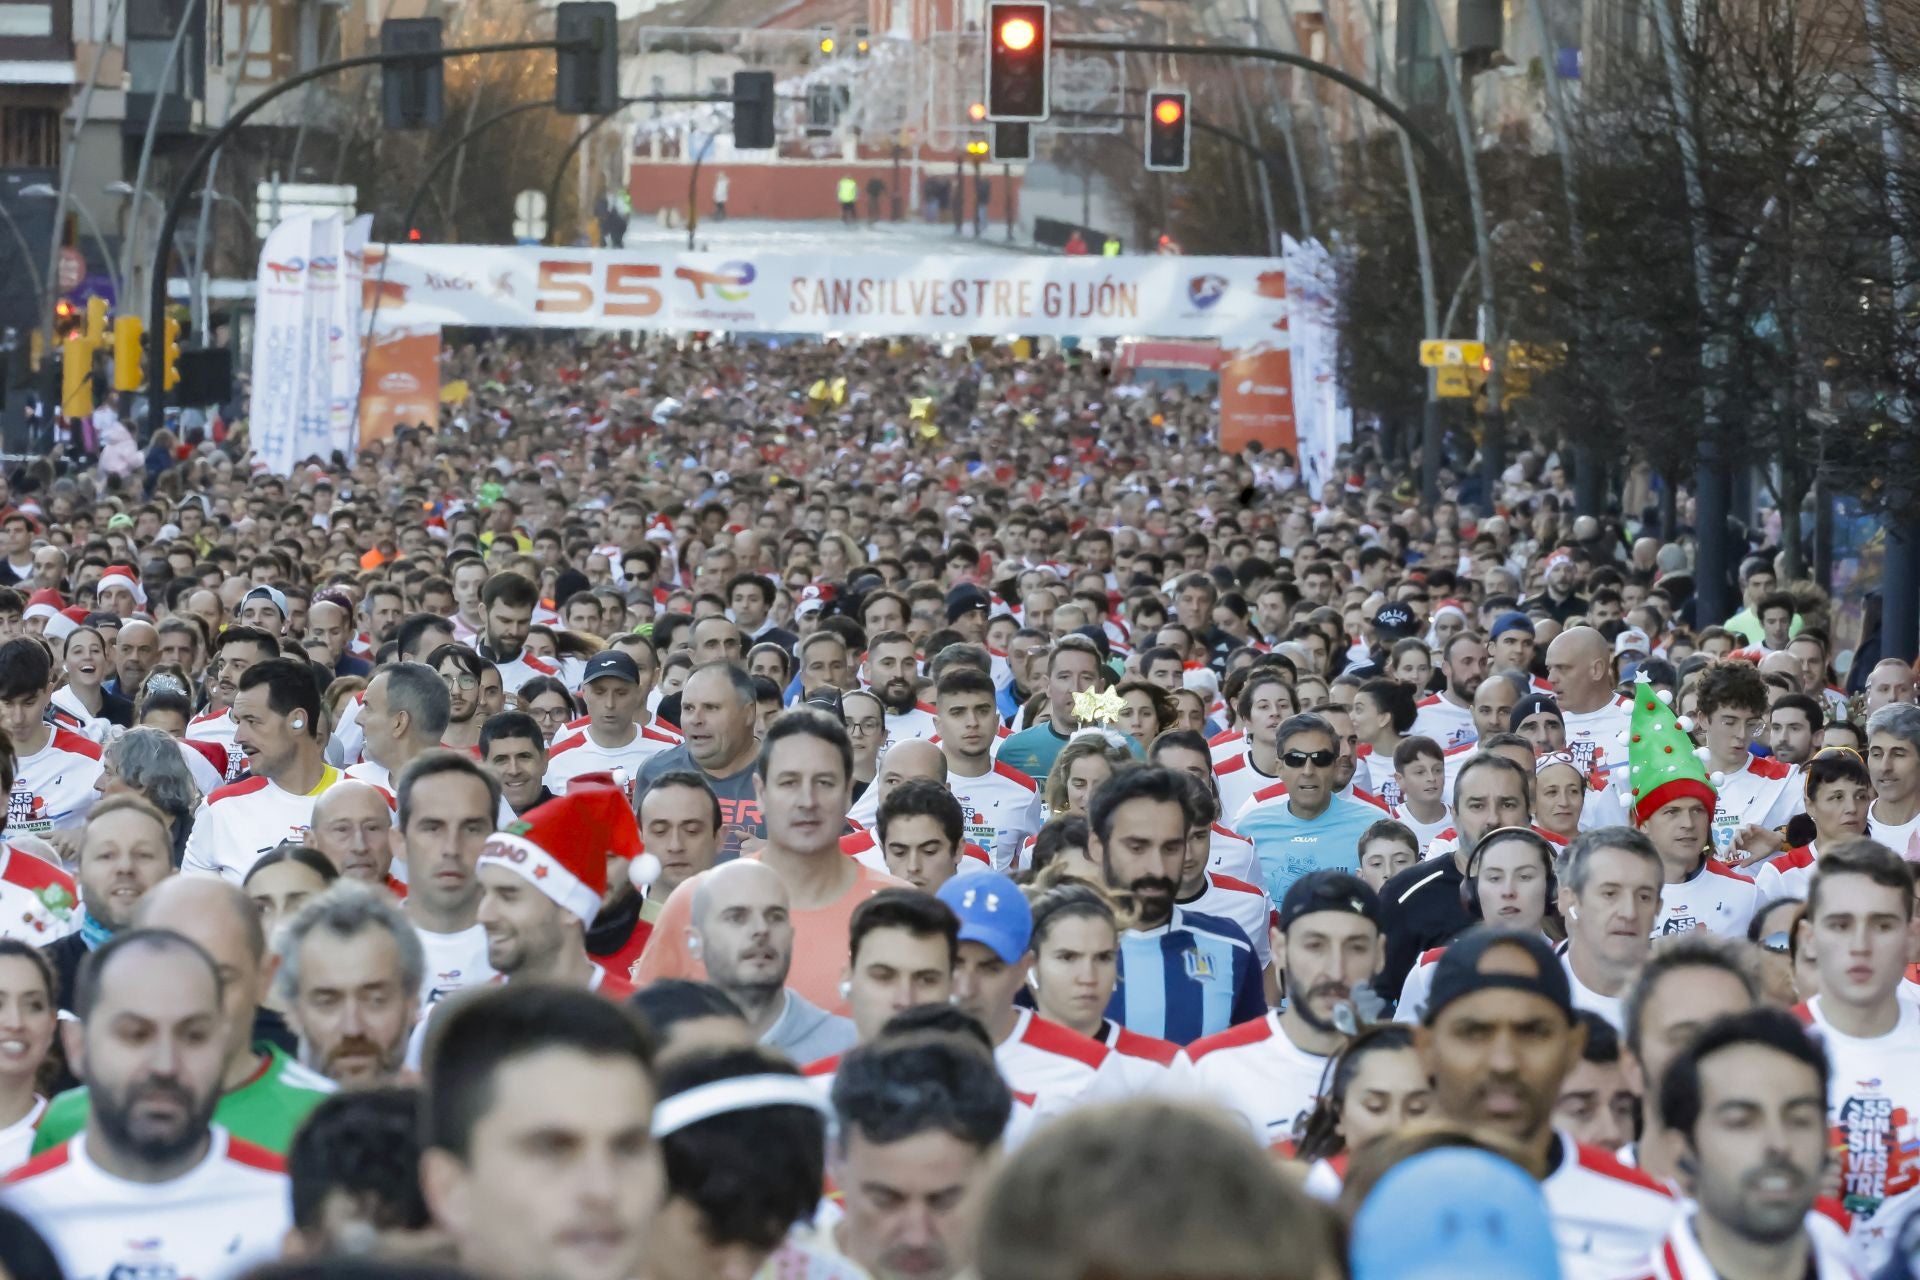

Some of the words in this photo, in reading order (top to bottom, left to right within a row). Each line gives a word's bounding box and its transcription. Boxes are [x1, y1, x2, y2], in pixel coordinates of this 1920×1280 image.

[535, 261, 663, 316] 55
[1042, 274, 1138, 319] GIJÓN
[14, 793, 33, 804] 55
[1863, 1100, 1892, 1117] 55
[1848, 1113, 1889, 1132] SAN
[1848, 1132, 1887, 1151] SIL
[1848, 1152, 1888, 1172] VES
[1845, 1173, 1885, 1197] TRE
